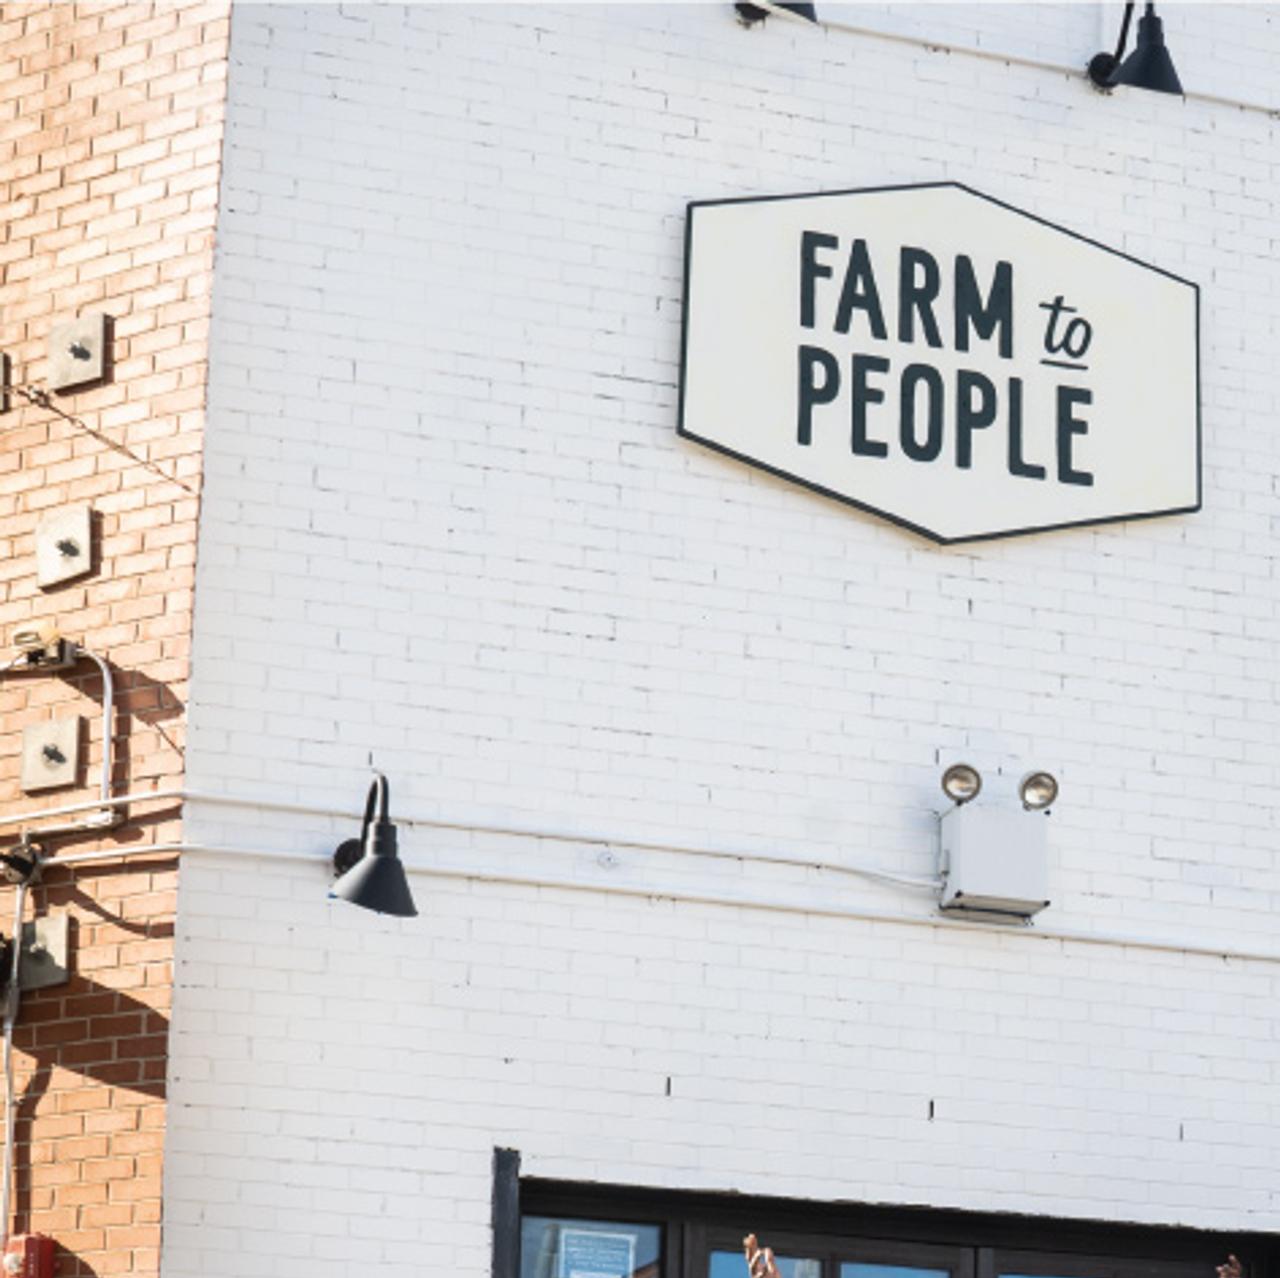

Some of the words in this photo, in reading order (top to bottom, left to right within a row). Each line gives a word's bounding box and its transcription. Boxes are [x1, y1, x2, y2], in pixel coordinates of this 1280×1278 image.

[799, 230, 1014, 360] FARM
[1038, 295, 1094, 370] to
[796, 344, 1094, 487] PEOPLE
